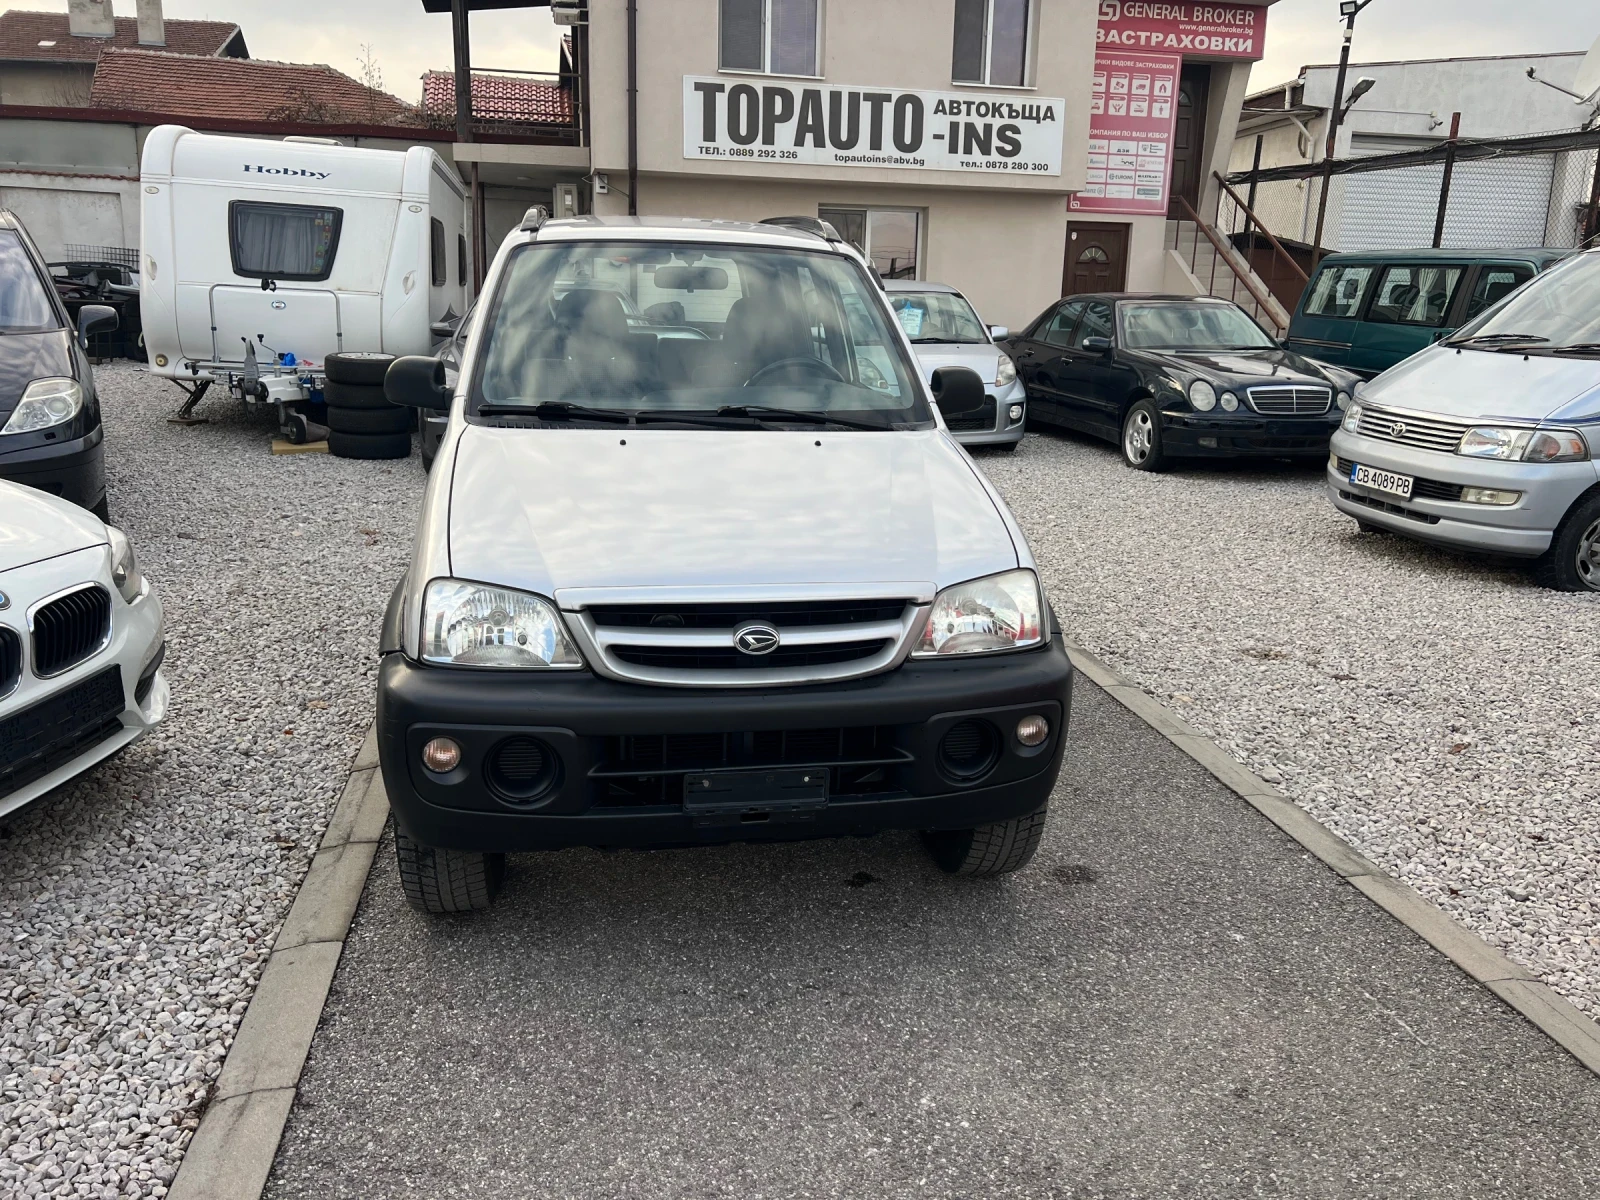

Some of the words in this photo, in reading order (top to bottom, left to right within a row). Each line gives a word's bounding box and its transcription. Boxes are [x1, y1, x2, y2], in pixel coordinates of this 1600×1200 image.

[1124, 1, 1188, 21] GENERAL
[1193, 6, 1255, 25] BROKER
[1179, 23, 1254, 36] www.generalbroker.bg
[1096, 28, 1253, 52] ЗАСТРАХОВКИ
[1111, 59, 1135, 67] ВИДОВЕ
[1135, 61, 1175, 69] ЗАСТРАХОВКИ
[694, 81, 925, 153] TOPAUTO
[933, 98, 1056, 124] АВТОКЪЩА
[1089, 128, 1120, 136] ОМПАНИЯ
[698, 146, 726, 156] ТЕЛ.:
[729, 147, 754, 157] 0889
[757, 149, 776, 158] 292
[779, 150, 798, 159] 326
[834, 153, 925, 167] topautoins@abv.bg
[243, 164, 332, 180] Hobby
[960, 160, 983, 168] тел.:
[985, 160, 1009, 170] 0878
[1011, 162, 1029, 171] 280
[1031, 163, 1049, 172] 300
[1357, 468, 1370, 483] CB
[1371, 472, 1395, 490] 4089
[1396, 477, 1410, 494] PB
